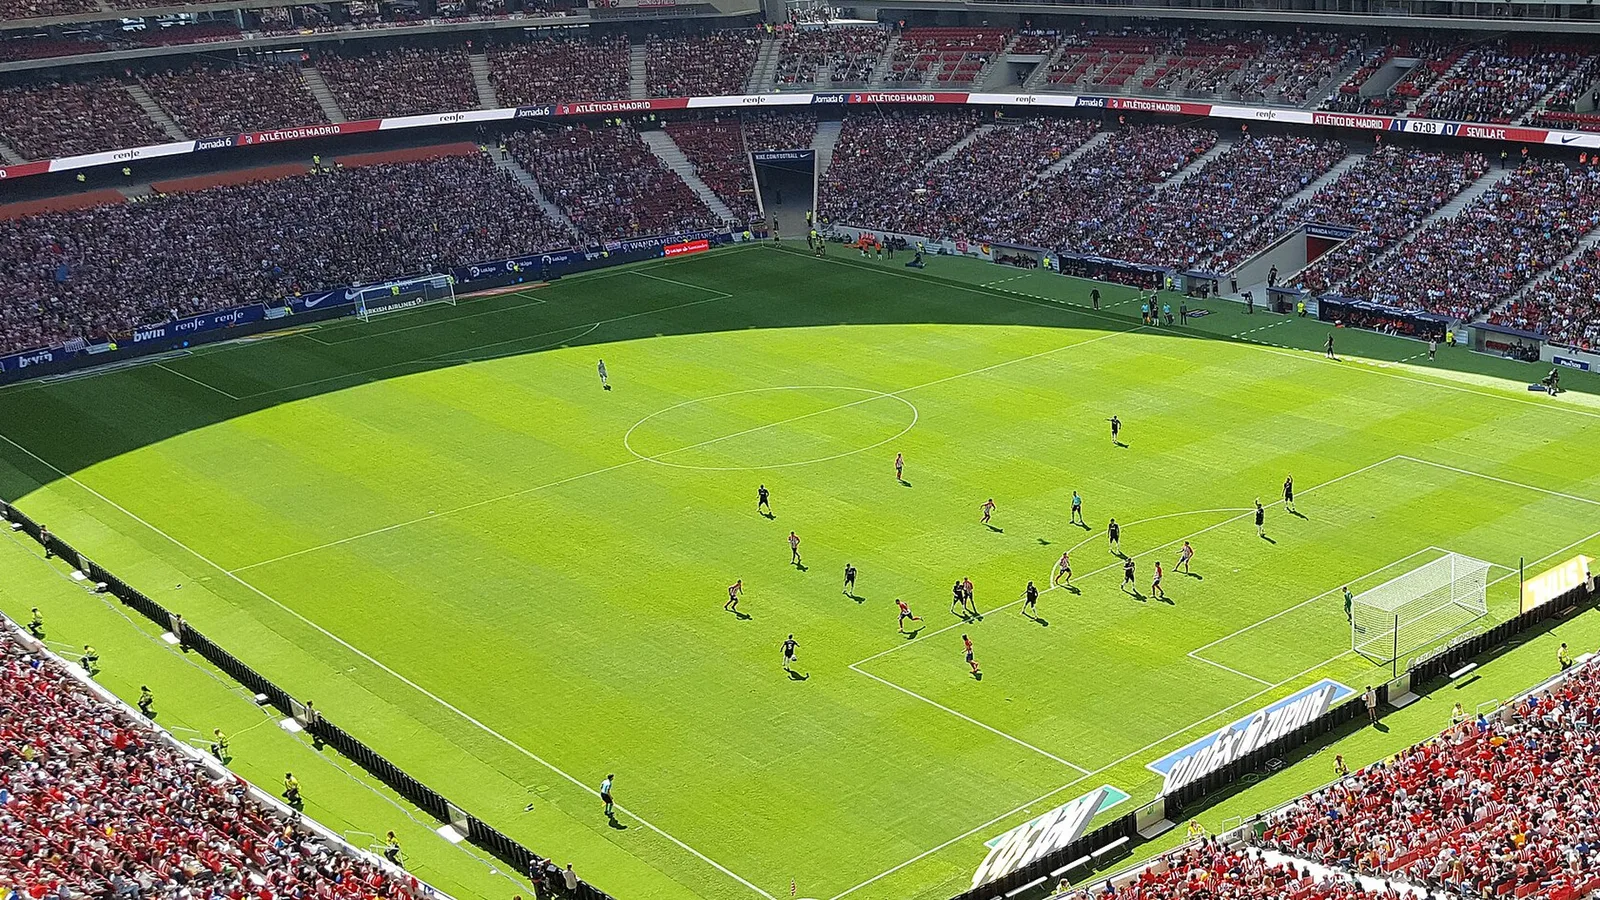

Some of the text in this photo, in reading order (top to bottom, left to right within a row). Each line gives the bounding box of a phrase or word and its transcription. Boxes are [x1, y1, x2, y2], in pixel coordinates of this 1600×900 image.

[815, 94, 844, 104] Jornada 6
[867, 92, 900, 102] ATLÉTICO
[906, 94, 935, 102] MADRID
[1078, 98, 1104, 107] Jornada 6
[517, 106, 550, 118] Jornada 6
[575, 102, 612, 113] ATLÉTICO
[619, 101, 651, 110] MADRID
[1122, 100, 1150, 110] ATLÉTICO
[1156, 103, 1181, 112] MADRID
[439, 112, 464, 123] renfe
[1255, 110, 1277, 120] renfe
[1314, 115, 1383, 129] ATLÉTICO DE MADRID
[1396, 120, 1401, 130] 1
[1412, 122, 1436, 133] 67:03
[259, 130, 299, 142] ATLÉTICO
[306, 126, 340, 137] MADRID
[1446, 124, 1453, 135] 0
[1467, 127, 1505, 139] SEVILLA FC
[197, 137, 232, 150] Jornada 6
[113, 149, 140, 160] renfe
[214, 310, 244, 325] renfe
[175, 317, 205, 333] renfe
[133, 327, 165, 343] bwin
